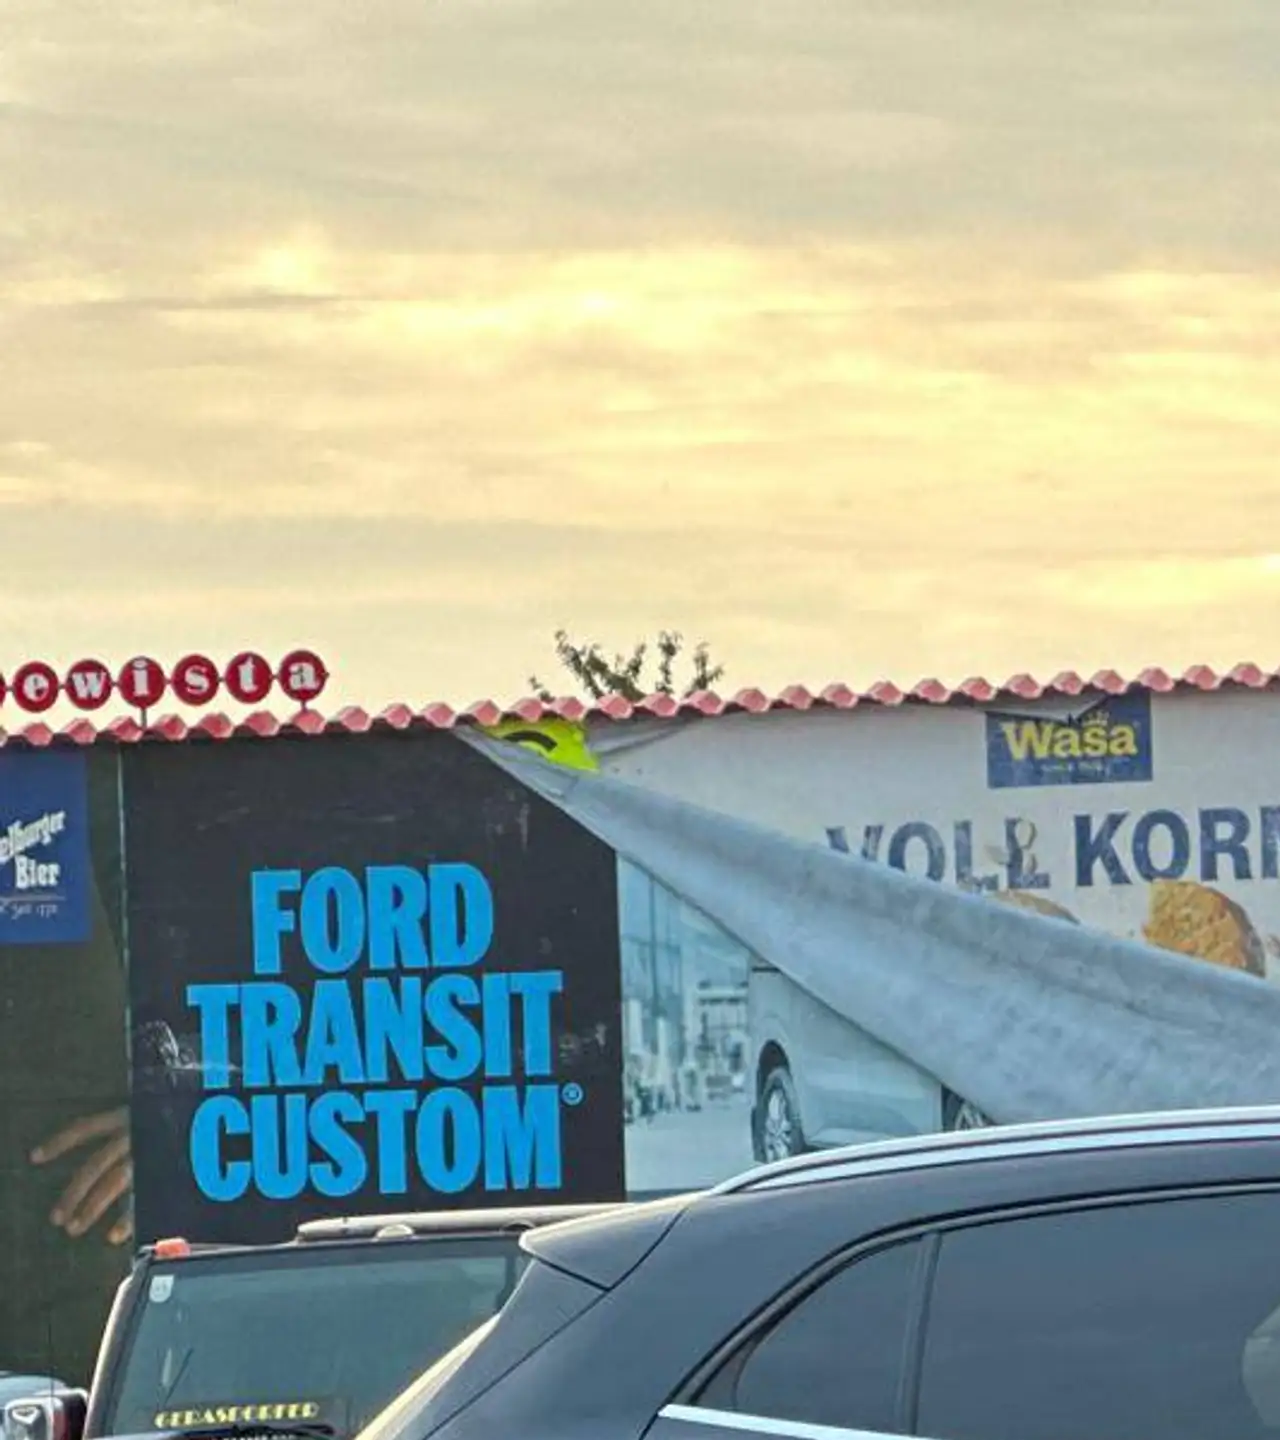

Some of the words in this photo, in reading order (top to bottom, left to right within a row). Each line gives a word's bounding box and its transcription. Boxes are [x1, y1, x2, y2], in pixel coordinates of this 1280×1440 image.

[22, 656, 320, 702] ewista
[1001, 718, 1139, 761] Wasa
[0, 810, 66, 864] elburger
[14, 854, 60, 889] Bier
[250, 862, 494, 974] FORD
[186, 970, 563, 1090] TRANSIT
